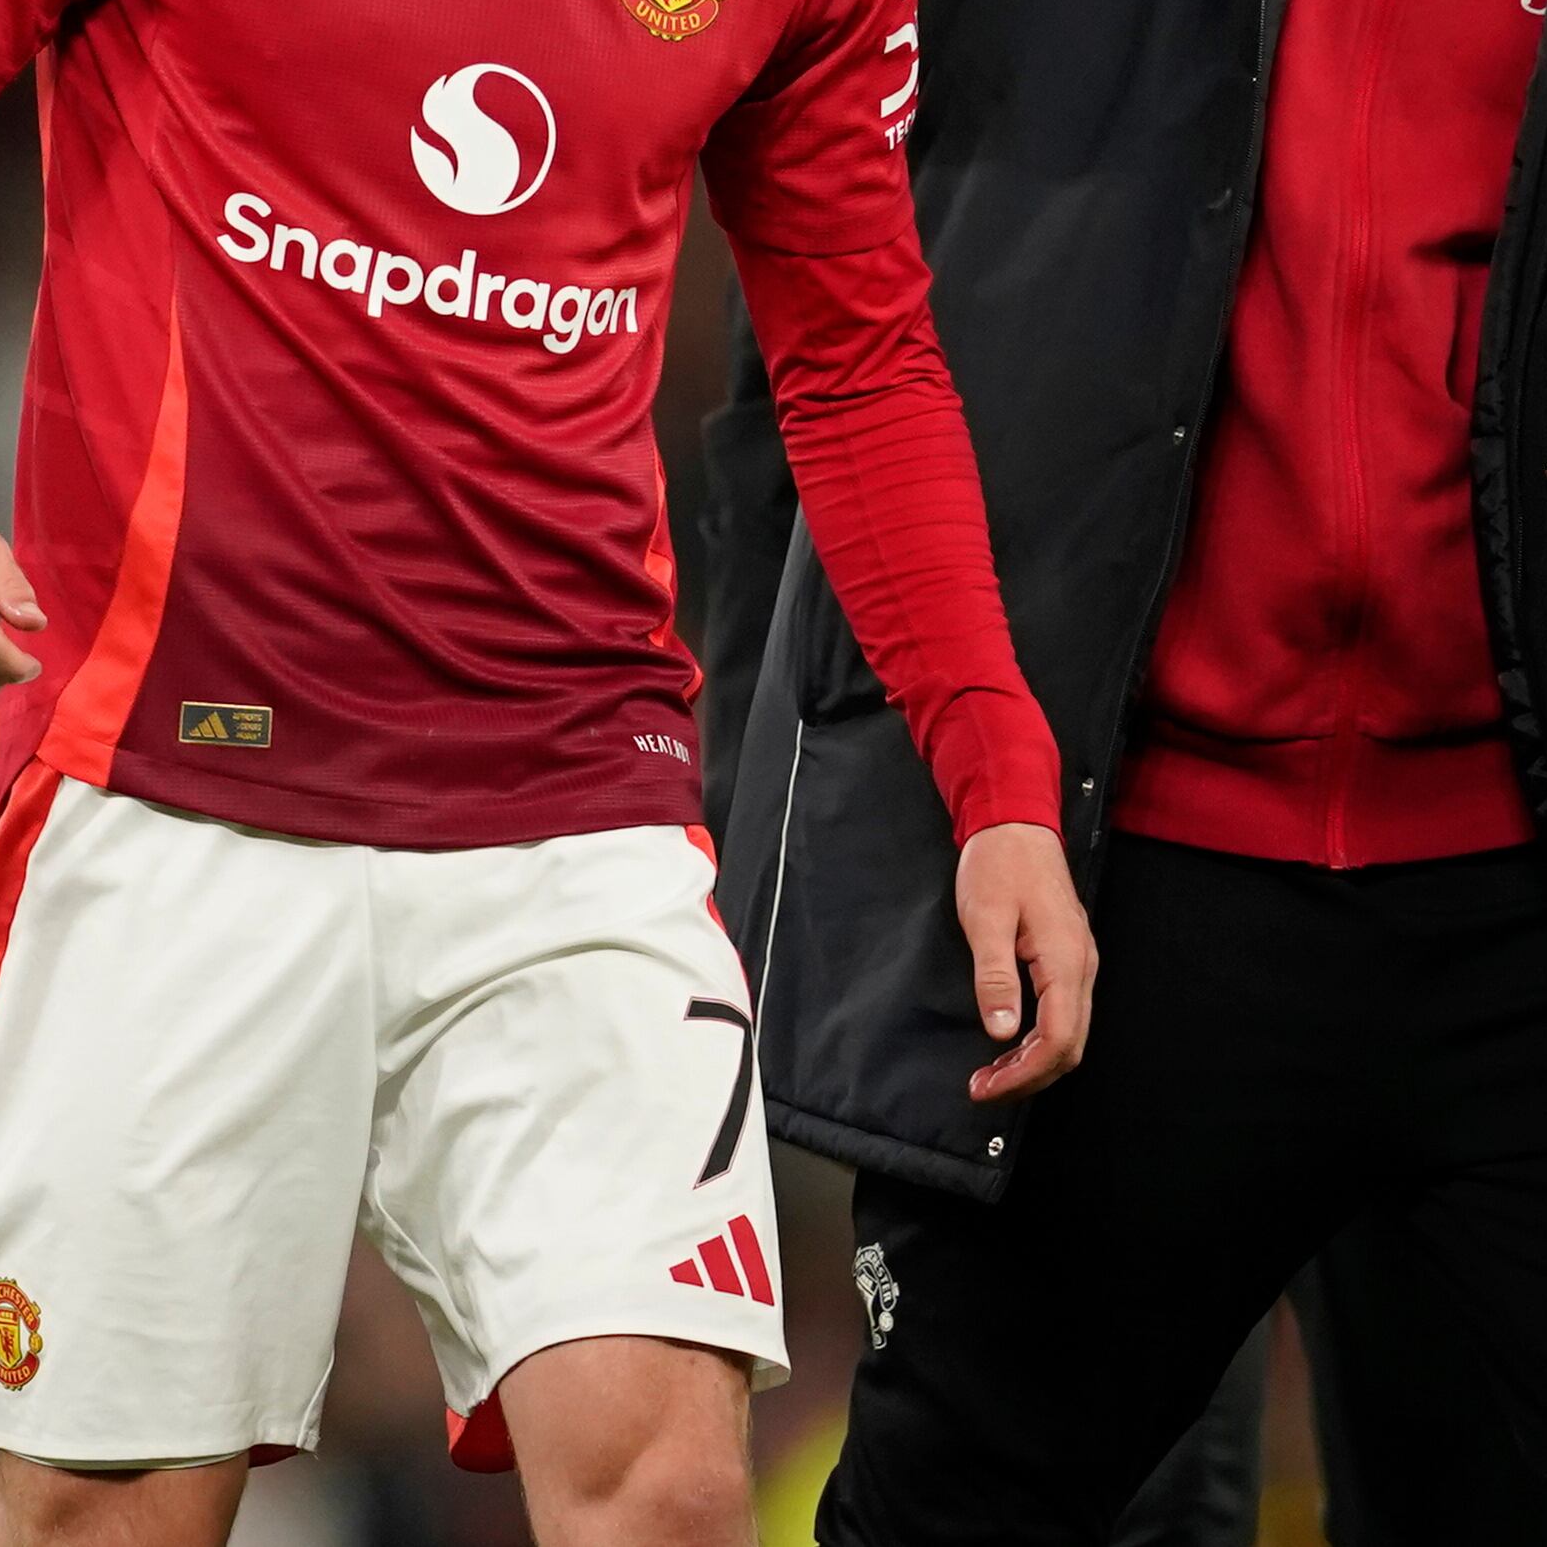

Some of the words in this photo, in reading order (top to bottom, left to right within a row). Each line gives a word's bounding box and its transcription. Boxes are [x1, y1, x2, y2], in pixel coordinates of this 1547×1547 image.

[636, 0, 701, 31] UNITED
[216, 192, 639, 354] Snapdragon
[684, 996, 754, 1190] 7
